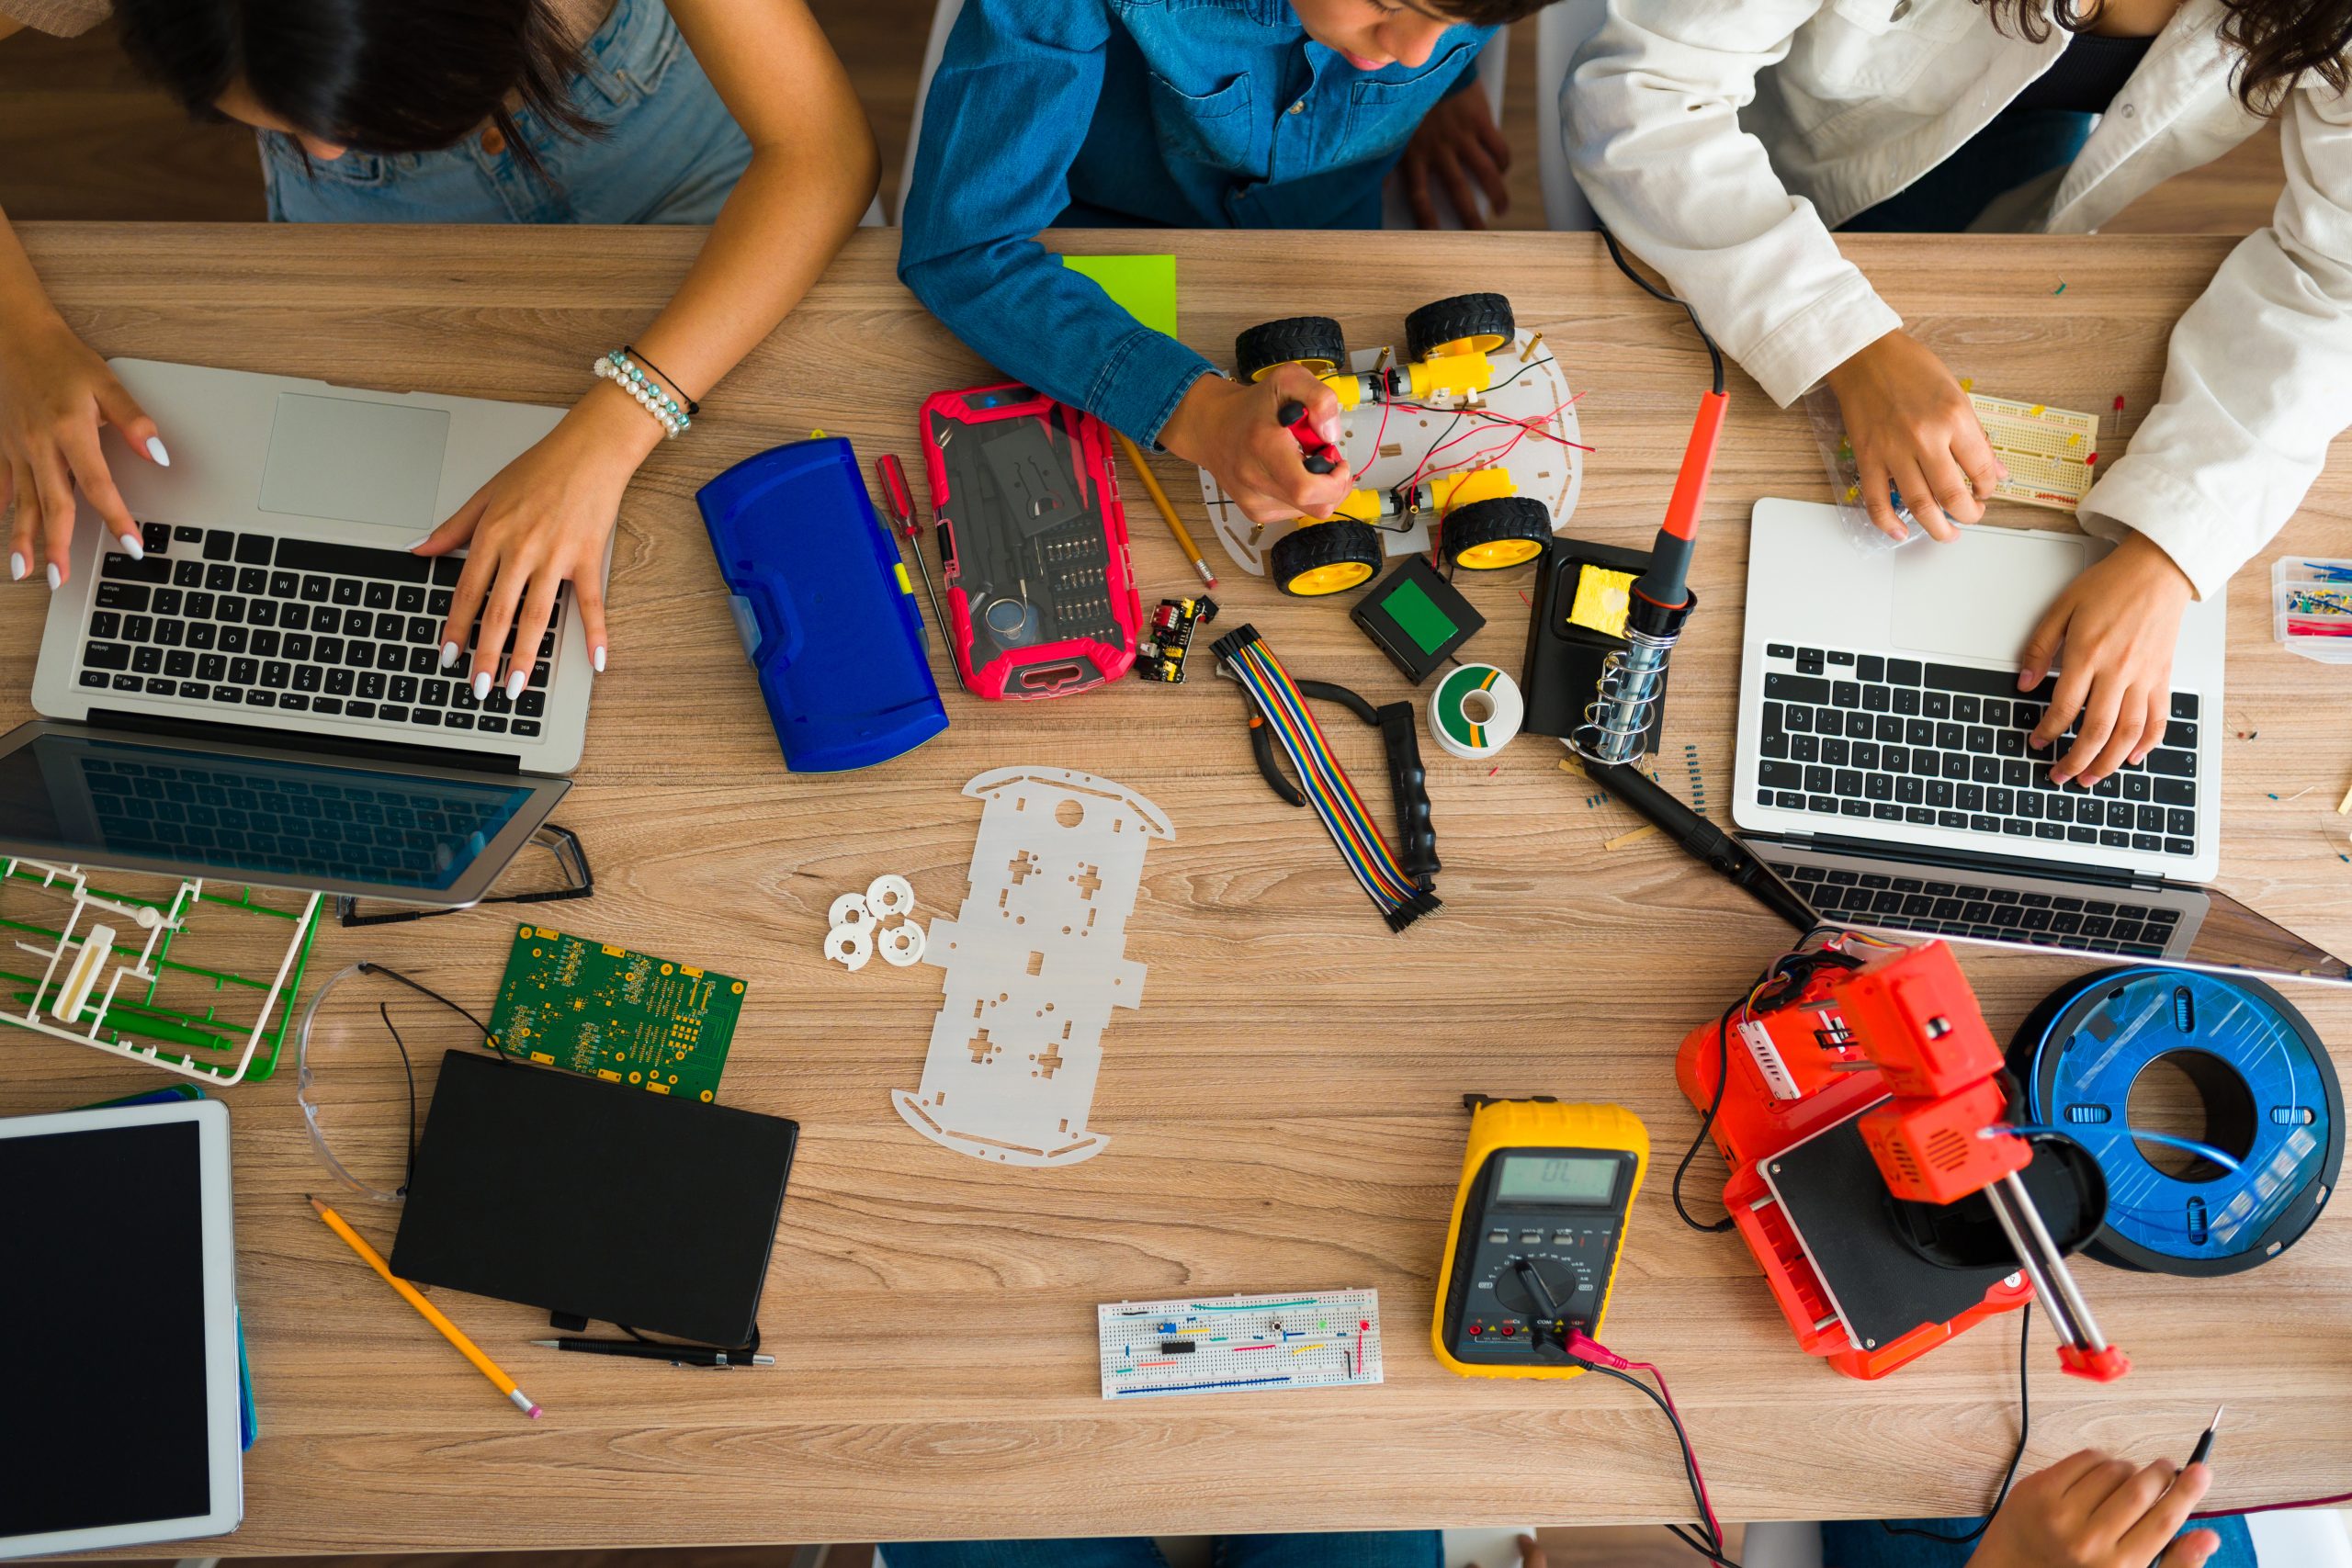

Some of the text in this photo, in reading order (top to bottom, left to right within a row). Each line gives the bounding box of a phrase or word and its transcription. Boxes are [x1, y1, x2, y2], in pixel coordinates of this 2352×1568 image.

[279, 580, 288, 590] M
[311, 583, 320, 592] N
[344, 587, 350, 596] B
[375, 591, 382, 600] V
[407, 594, 414, 604] C
[438, 598, 446, 607] X
[228, 604, 233, 614] L
[258, 608, 266, 617] K
[291, 611, 298, 621] J
[321, 615, 330, 625] H
[354, 618, 362, 628] G
[386, 622, 392, 632] F
[417, 626, 425, 635] D
[197, 631, 204, 640] P
[228, 635, 237, 644] O
[262, 638, 266, 648] I
[292, 641, 300, 651] U
[91, 644, 109, 652] delete
[324, 646, 331, 655] Y
[356, 649, 363, 659] T
[389, 652, 396, 662] R
[209, 658, 215, 667] 0
[420, 656, 427, 666] E
[241, 661, 247, 671] 9
[273, 665, 279, 674] 8
[304, 669, 311, 678] 7
[337, 672, 344, 681] 6
[368, 676, 376, 685] 5
[401, 680, 407, 689] 4
[433, 683, 439, 693] 3
[464, 687, 470, 695] 2
[497, 691, 501, 699] 1
[1933, 701, 1941, 710] M
[1963, 705, 1971, 714] N
[1994, 708, 2000, 717] B
[2024, 712, 2030, 720] V
[1796, 712, 1804, 723] Ç
[1857, 721, 1864, 731] Ñ
[1888, 725, 1894, 733] L
[1917, 728, 1924, 738] K
[1948, 731, 1953, 740] J
[1977, 735, 1984, 744] H
[2007, 739, 2014, 748] G
[1862, 751, 1870, 760] P
[1893, 754, 1900, 763] O
[1925, 759, 1928, 767] I
[1953, 761, 1961, 771] U
[1984, 765, 1990, 774] Y
[2014, 769, 2020, 778] T
[1876, 778, 1883, 787] 0
[1906, 781, 1913, 791] 9
[2102, 779, 2112, 789] W
[1937, 784, 1943, 794] 8
[2133, 783, 2142, 792] Q
[1967, 789, 1973, 797] 7
[1997, 792, 2004, 801] 6
[2028, 795, 2034, 805] 5
[2058, 799, 2064, 808] 4
[2088, 803, 2095, 812] 3
[2119, 807, 2124, 816] 2
[2150, 810, 2154, 818] 1
